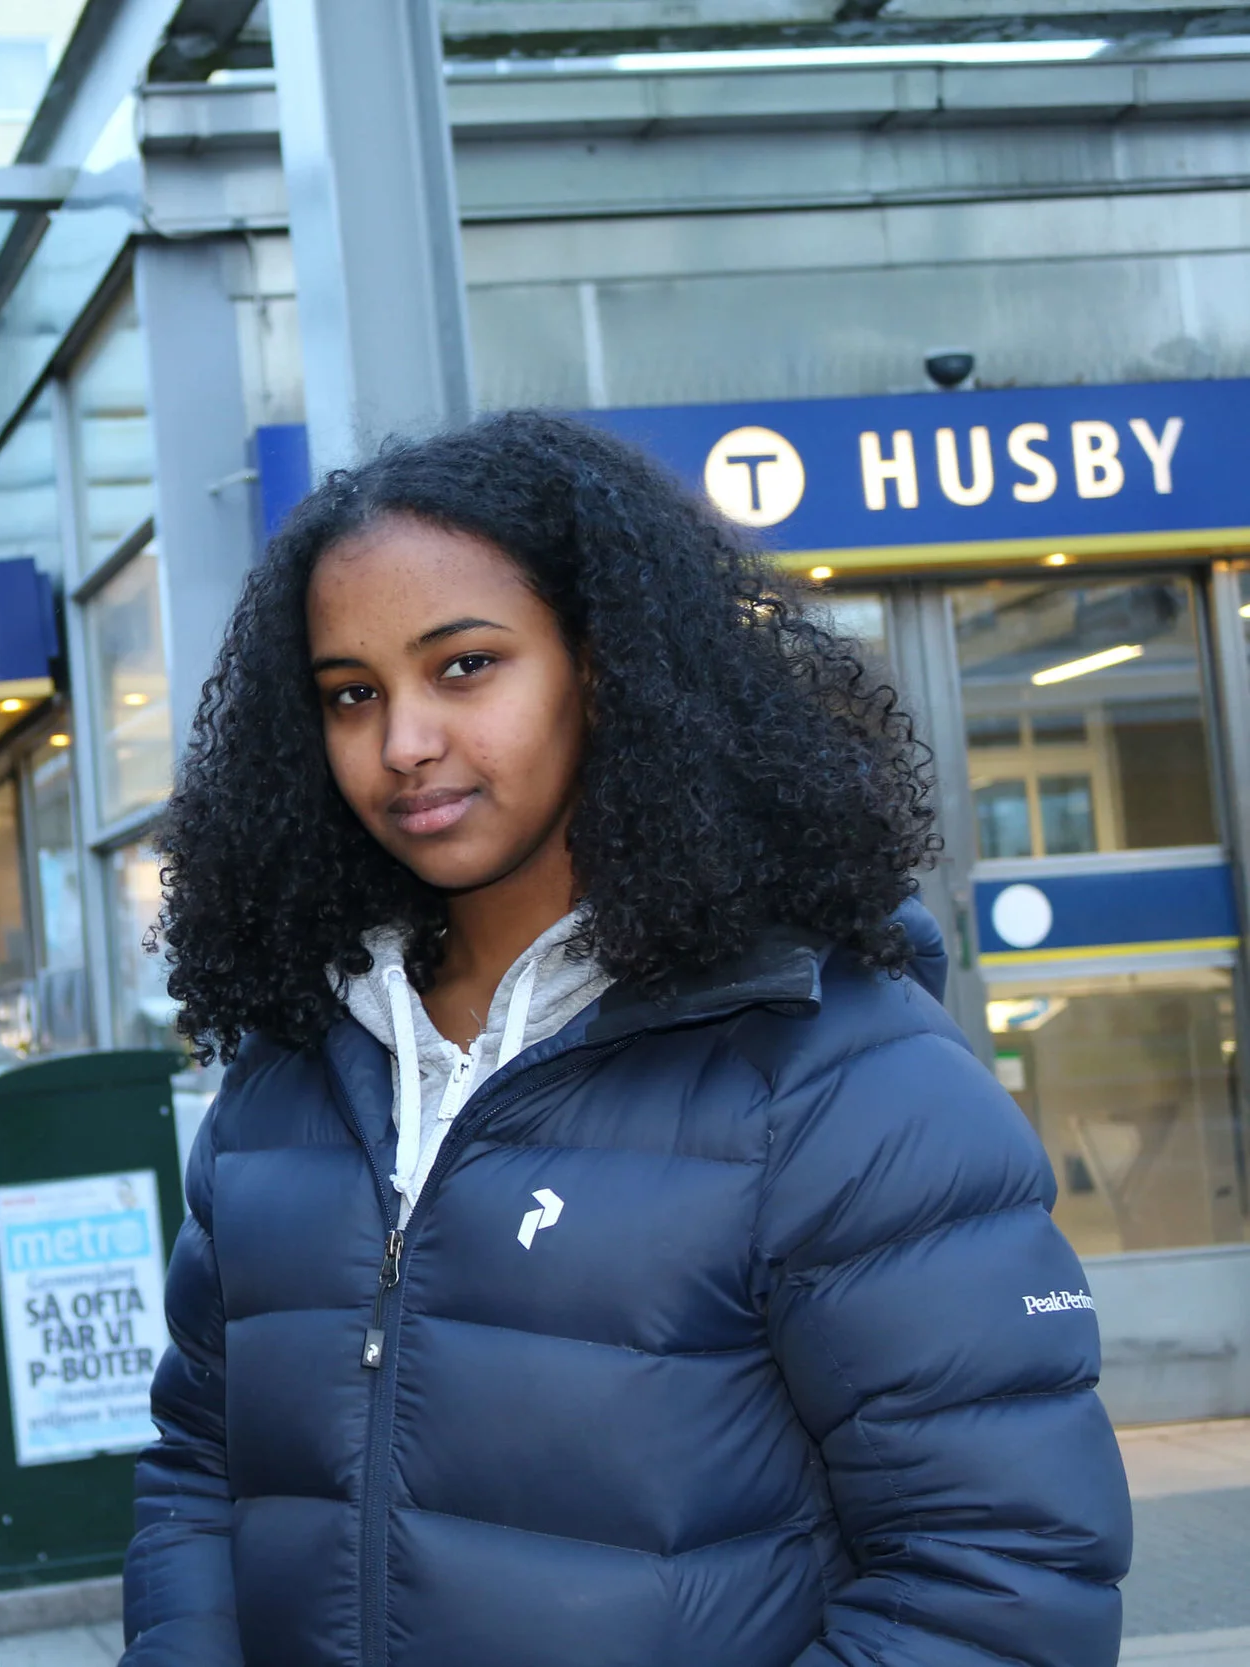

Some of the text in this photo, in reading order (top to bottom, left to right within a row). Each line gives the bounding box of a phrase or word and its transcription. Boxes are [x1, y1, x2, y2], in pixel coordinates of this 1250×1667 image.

[859, 417, 1184, 511] HUSBY
[10, 1218, 145, 1268] metro
[72, 1287, 145, 1319] OFTA
[104, 1318, 134, 1345] VI
